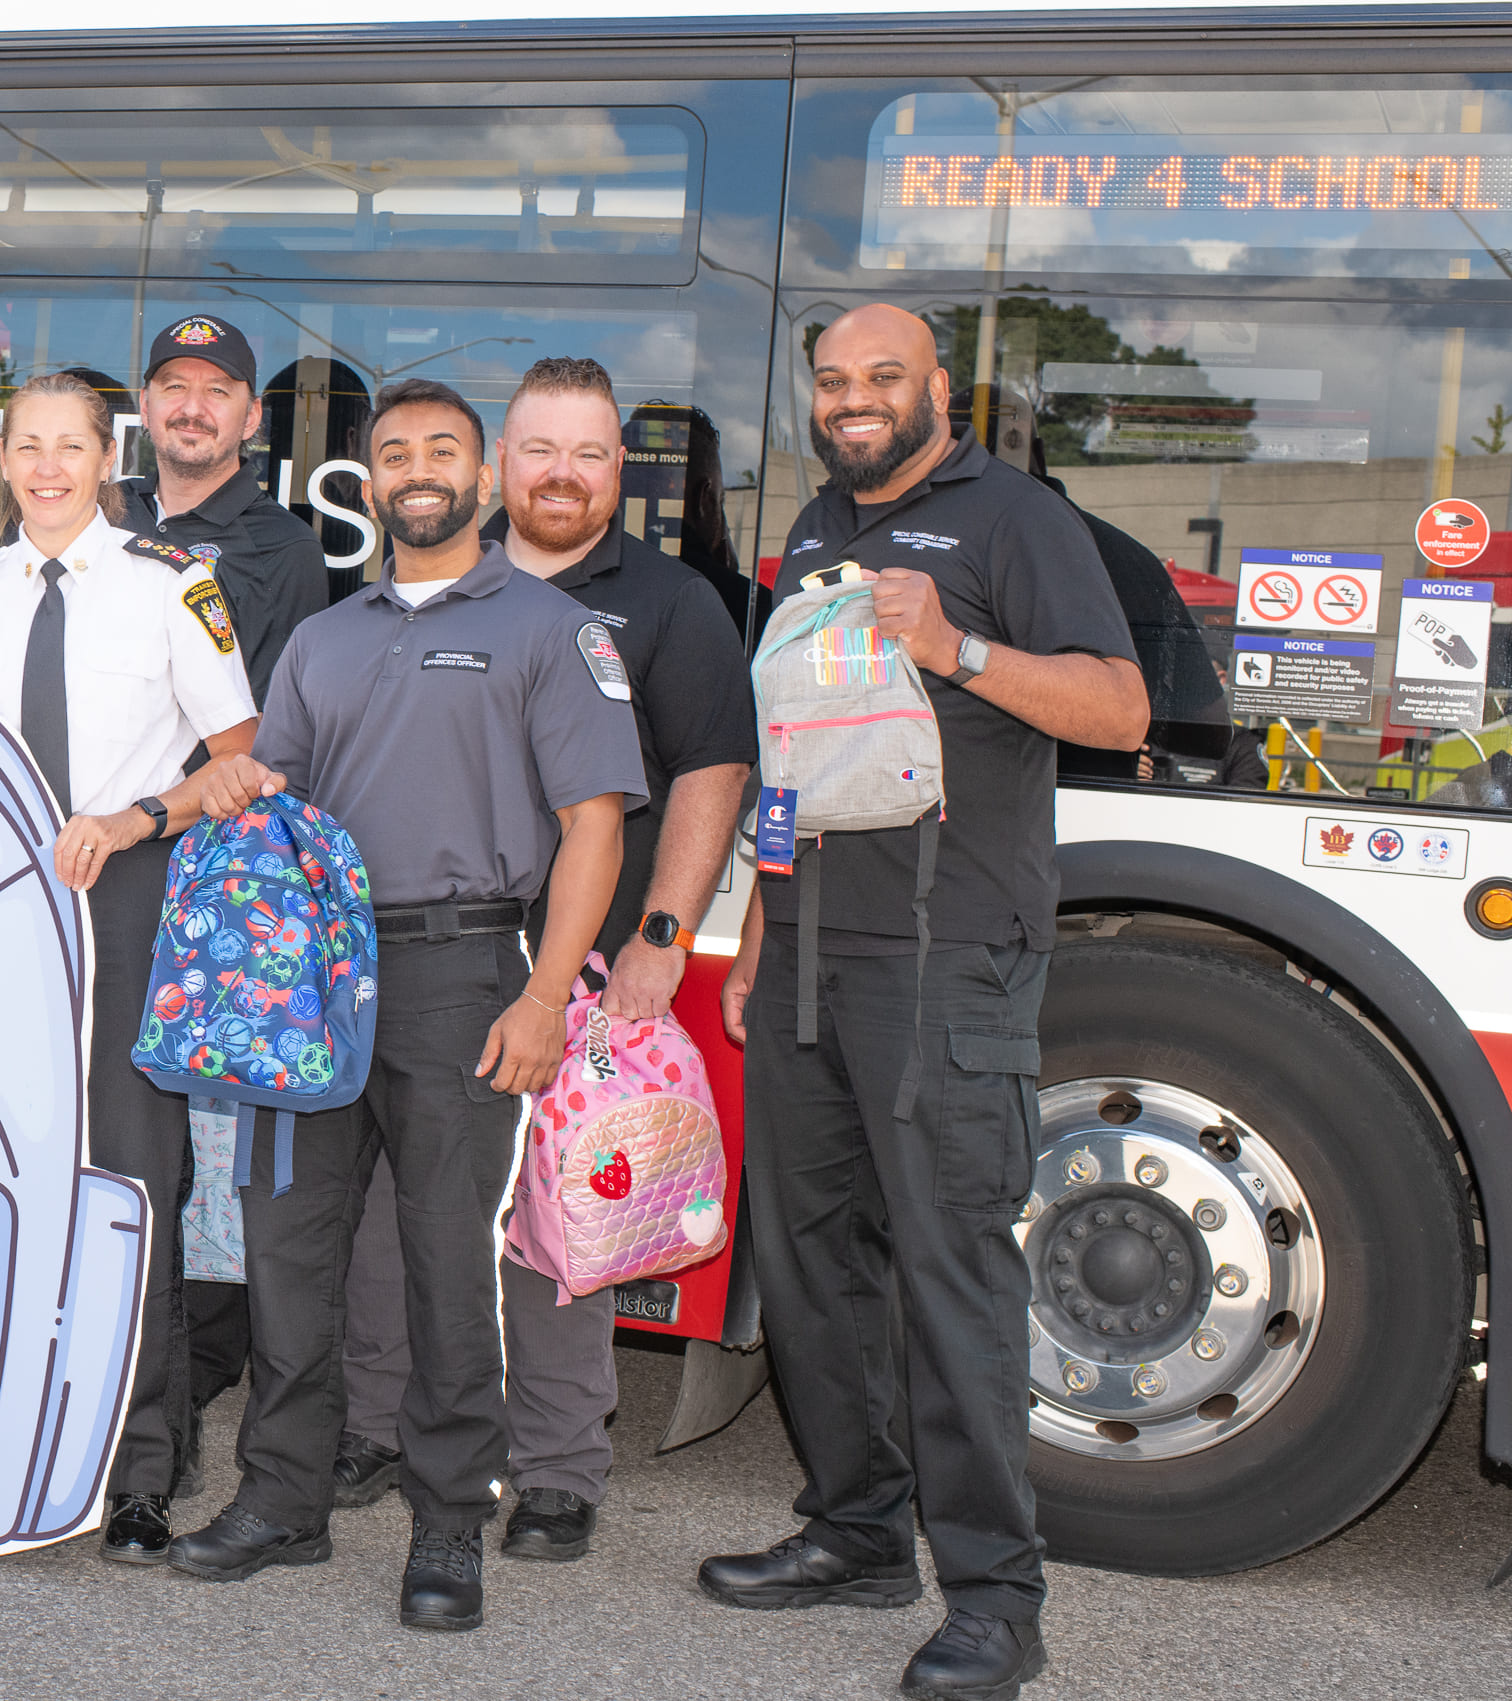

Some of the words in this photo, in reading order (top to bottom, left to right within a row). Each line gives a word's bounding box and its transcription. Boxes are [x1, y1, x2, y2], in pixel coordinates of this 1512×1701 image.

[900, 155, 1116, 206] READY
[1146, 156, 1186, 208] 4
[1220, 156, 1498, 210] SCHOOL
[624, 451, 656, 462] lease
[1423, 541, 1480, 549] enforcement
[1291, 553, 1332, 564] NOTICE
[1422, 584, 1473, 596] NOTICE
[1414, 614, 1446, 637] POP
[1284, 641, 1324, 651] NOTICE
[1276, 665, 1313, 673] monitored
[1330, 660, 1350, 668] being
[1290, 682, 1318, 690] security
[1346, 677, 1368, 685] safety
[1399, 684, 1478, 696] Proof-of-Payment
[1330, 835, 1345, 844] 113
[1373, 835, 1399, 844] CUPE
[1380, 847, 1390, 860] 2
[615, 1292, 670, 1318] lsior
